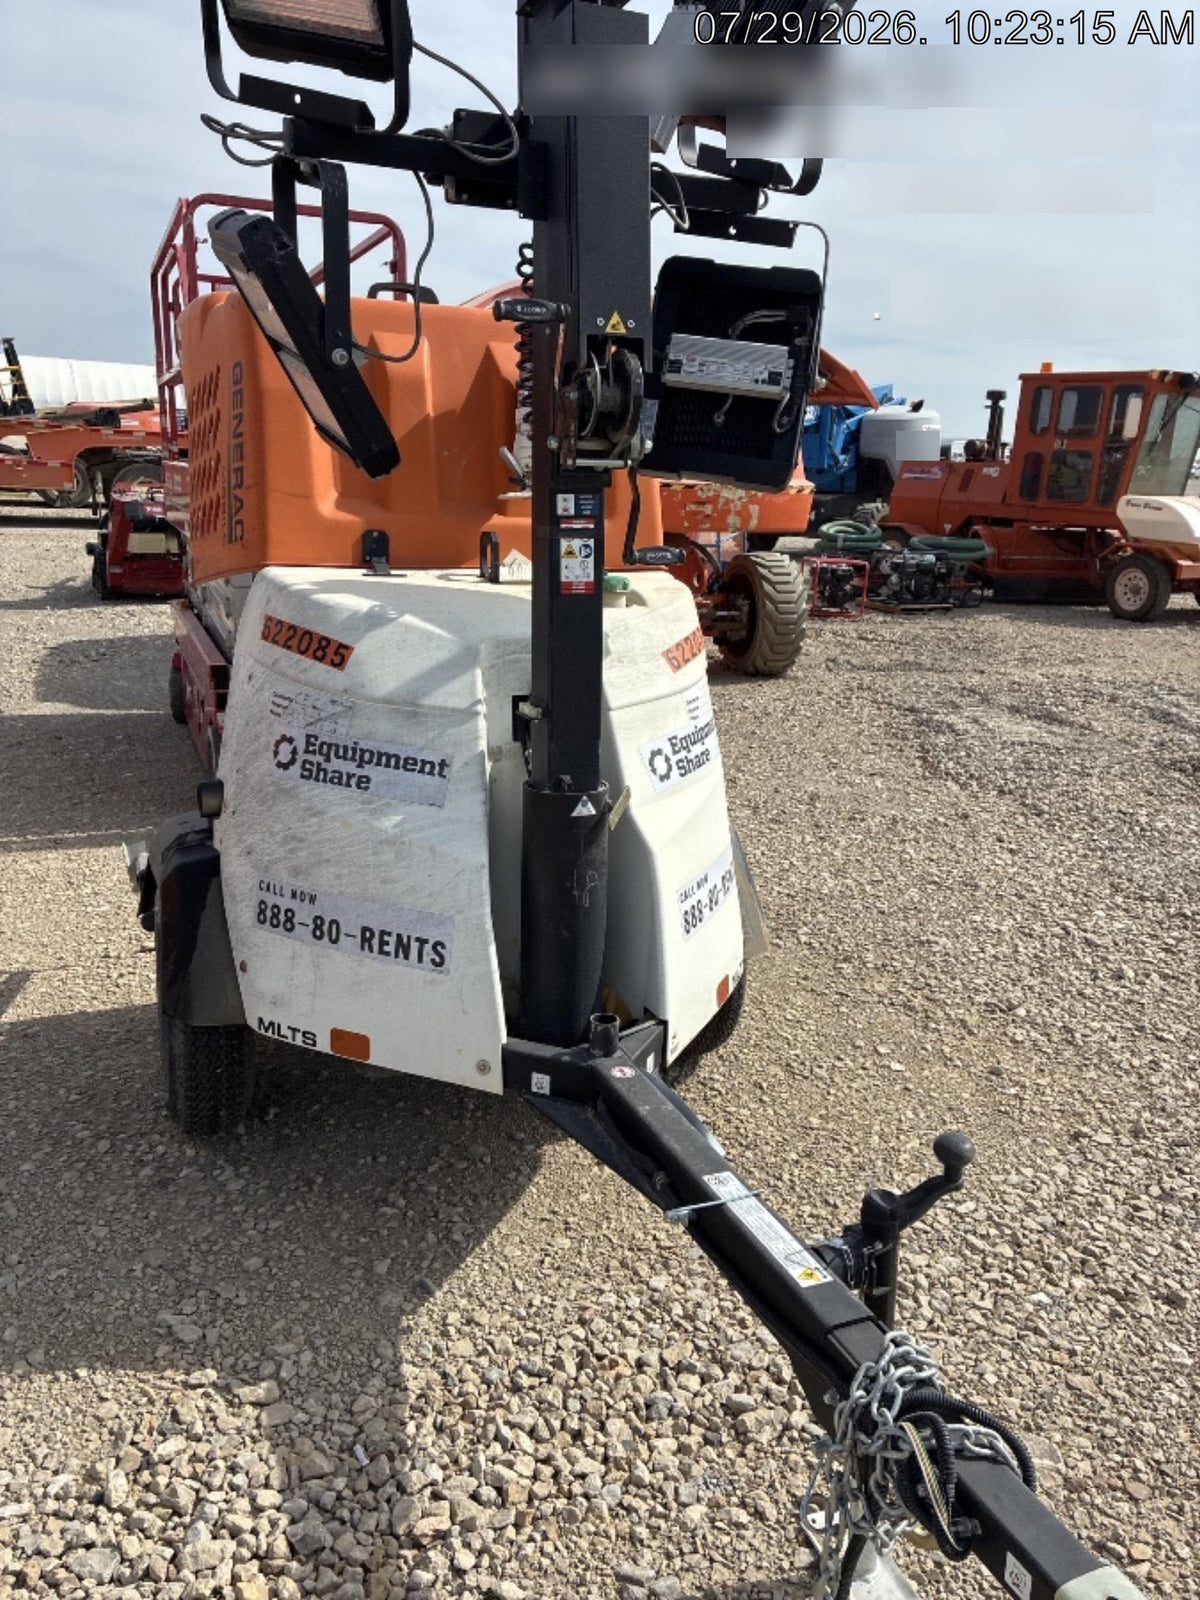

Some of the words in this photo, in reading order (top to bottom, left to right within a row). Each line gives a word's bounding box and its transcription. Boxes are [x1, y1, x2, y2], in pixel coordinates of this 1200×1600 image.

[231, 360, 245, 543] GENERAC
[261, 615, 350, 669] 622085
[300, 758, 372, 791] Share
[303, 733, 450, 779] Equipment
[675, 747, 710, 778] Share
[258, 879, 284, 897] CALL
[291, 888, 317, 905] NOW
[256, 899, 447, 968] 888-80-RENTS
[257, 1016, 318, 1047] MLTS
